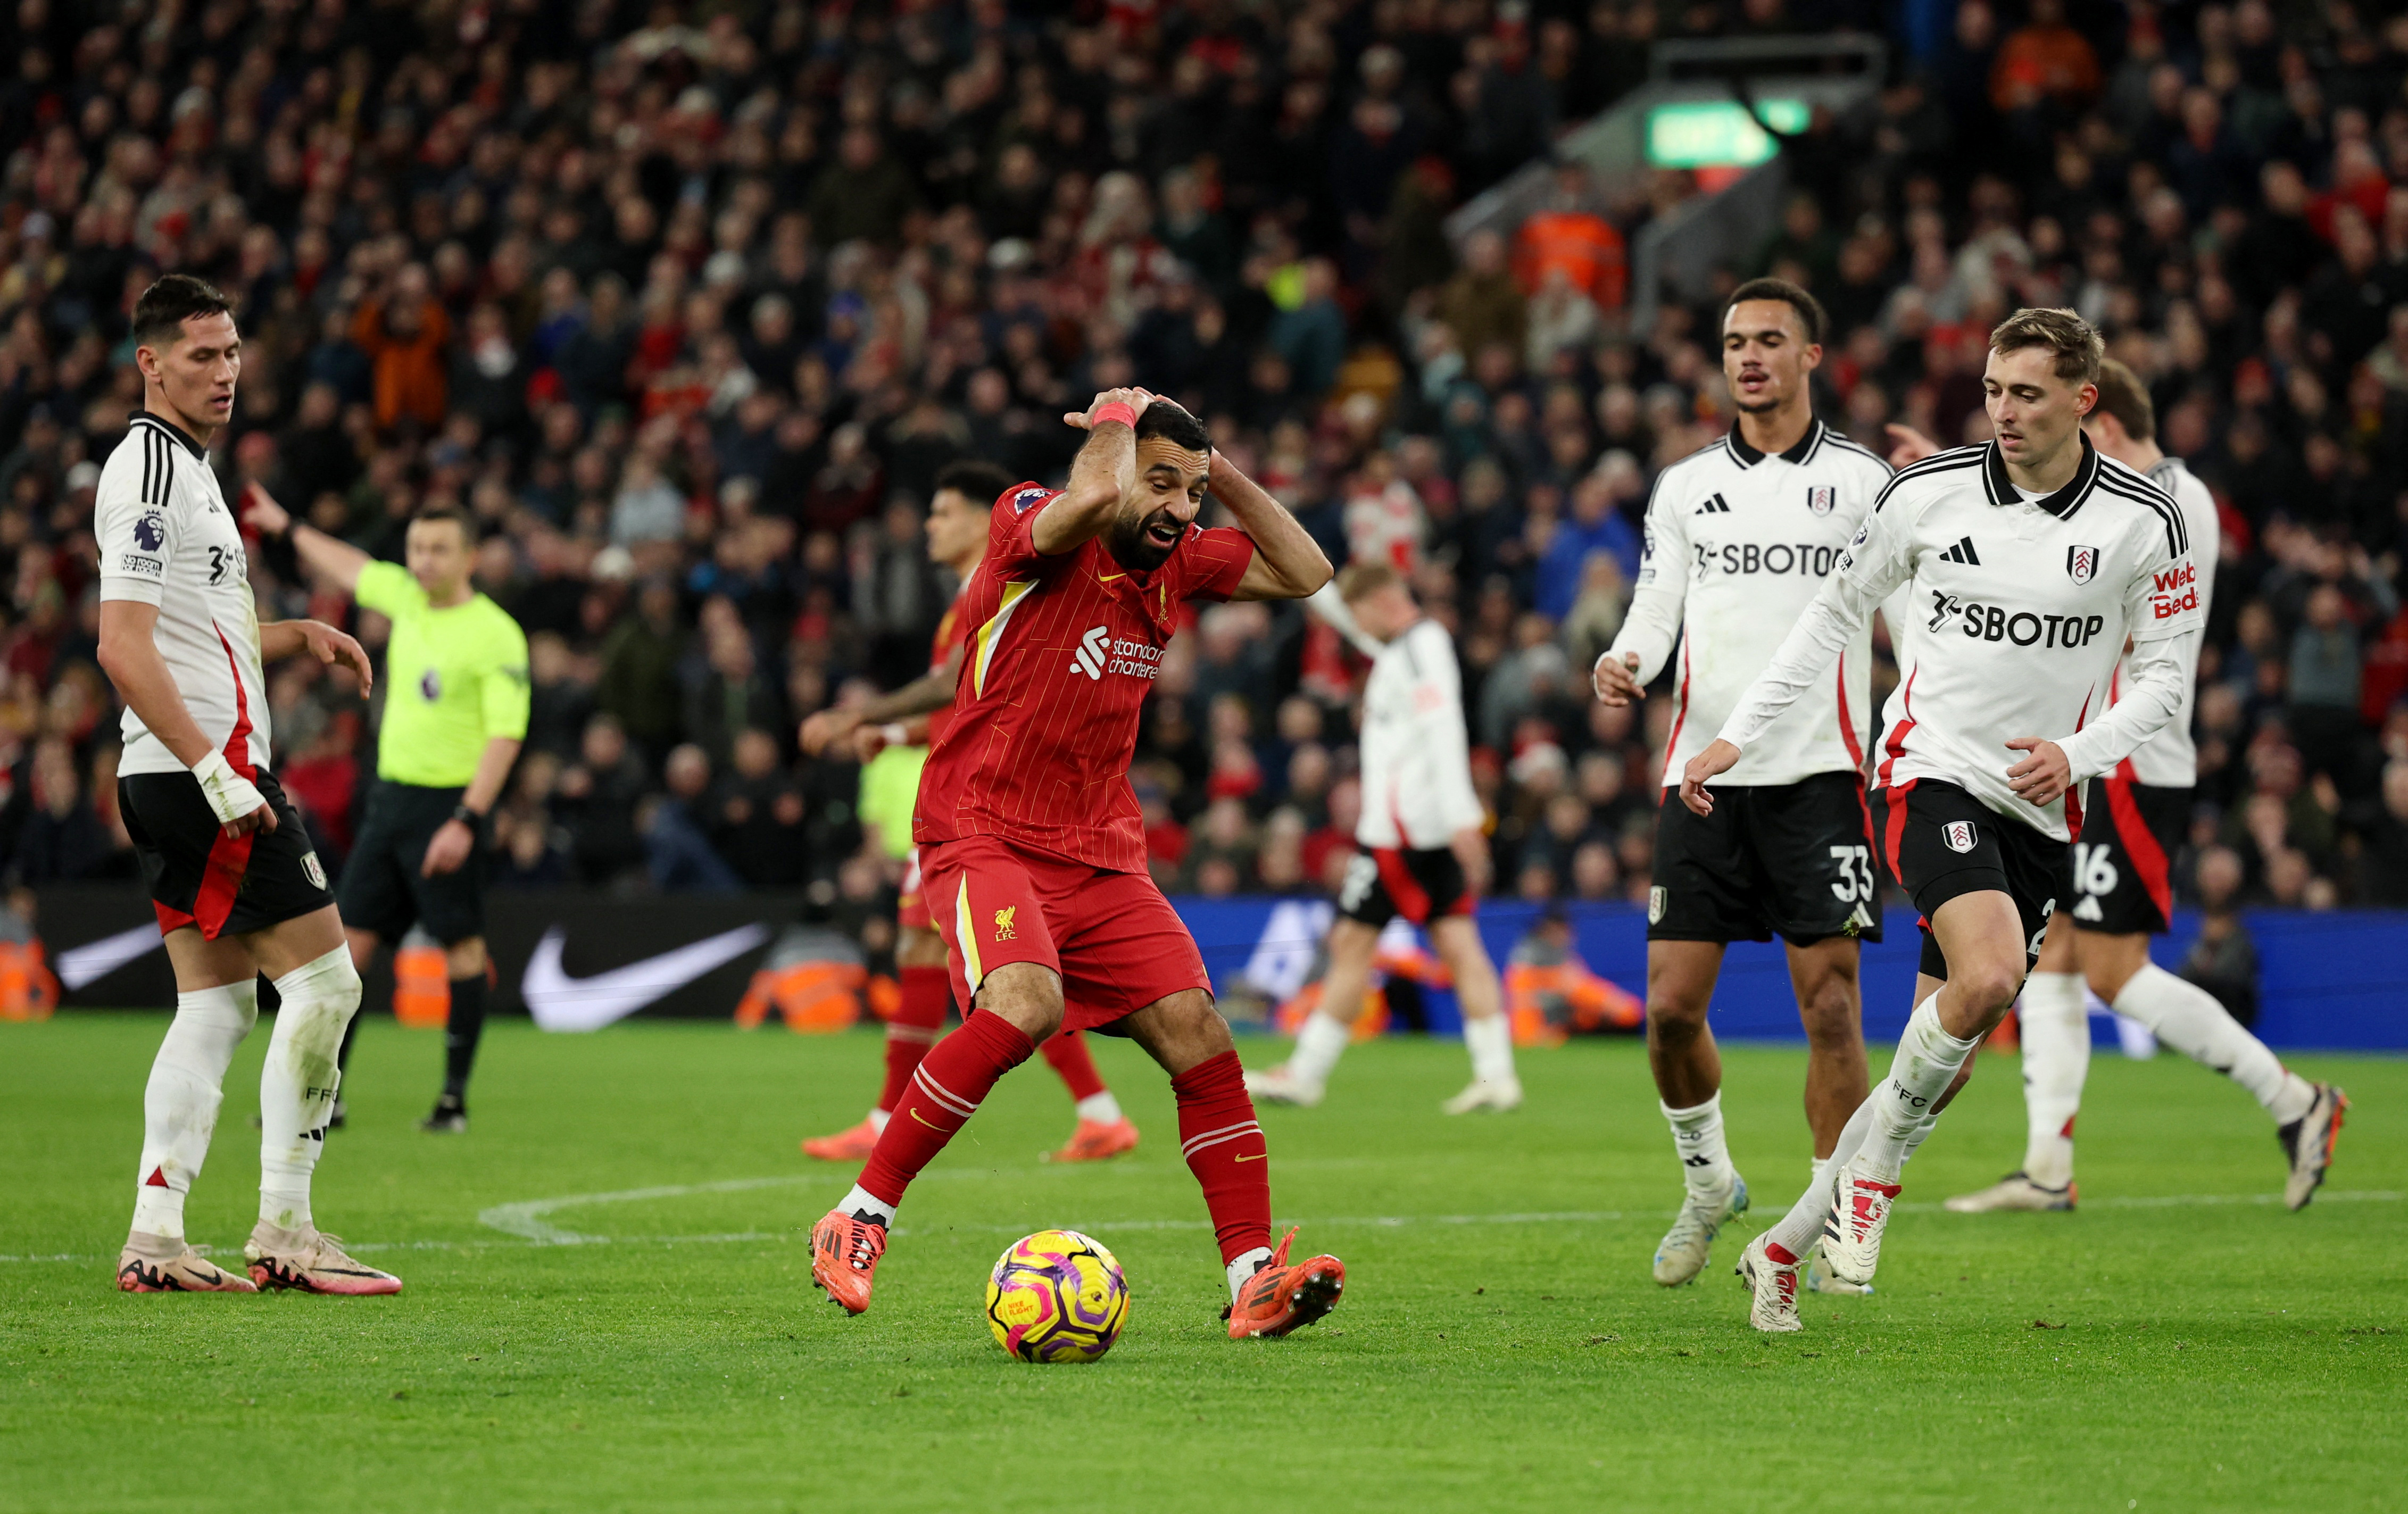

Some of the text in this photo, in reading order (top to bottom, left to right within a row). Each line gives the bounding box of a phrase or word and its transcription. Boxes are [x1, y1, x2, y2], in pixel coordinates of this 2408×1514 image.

[122, 554, 160, 571] No room
[2075, 550, 2091, 578] FFC
[2153, 561, 2196, 593] Web
[1963, 603, 2104, 648] SBOTOP
[1112, 637, 1165, 662] standar
[1108, 655, 1159, 679] chartere
[1952, 825, 1969, 846] FFC
[1830, 845, 1874, 903] 33
[2074, 842, 2119, 896] 16
[995, 931, 1018, 943] L.F.C.
[1893, 1079, 1928, 1108] FFC
[1008, 1300, 1024, 1309] NIKE
